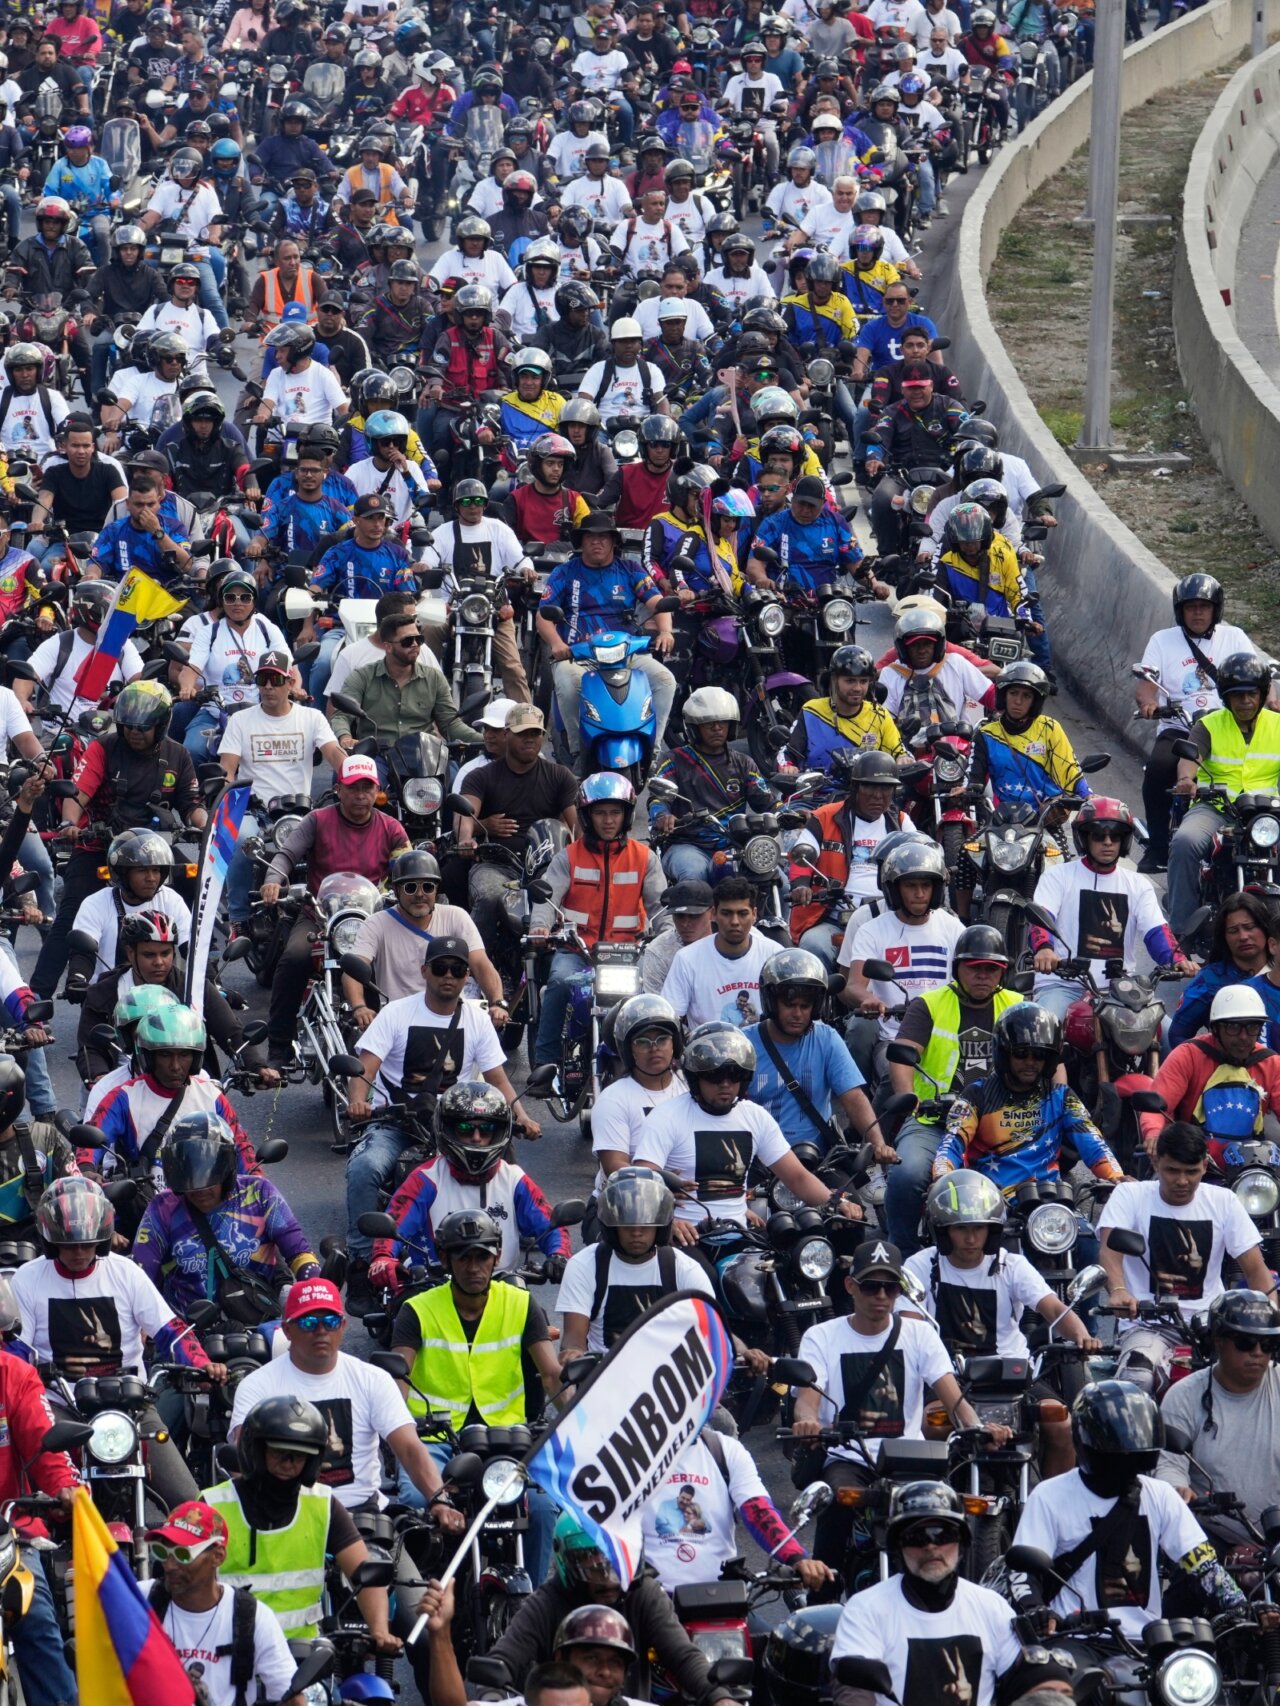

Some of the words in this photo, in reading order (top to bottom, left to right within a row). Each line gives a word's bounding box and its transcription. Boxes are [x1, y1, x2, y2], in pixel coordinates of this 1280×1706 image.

[256, 739, 298, 751] TOMMY
[272, 749, 299, 757] JEANS
[716, 982, 761, 996] LIBERTAD
[572, 1325, 713, 1526] SINBOM
[622, 1417, 696, 1523] VENEZUELA
